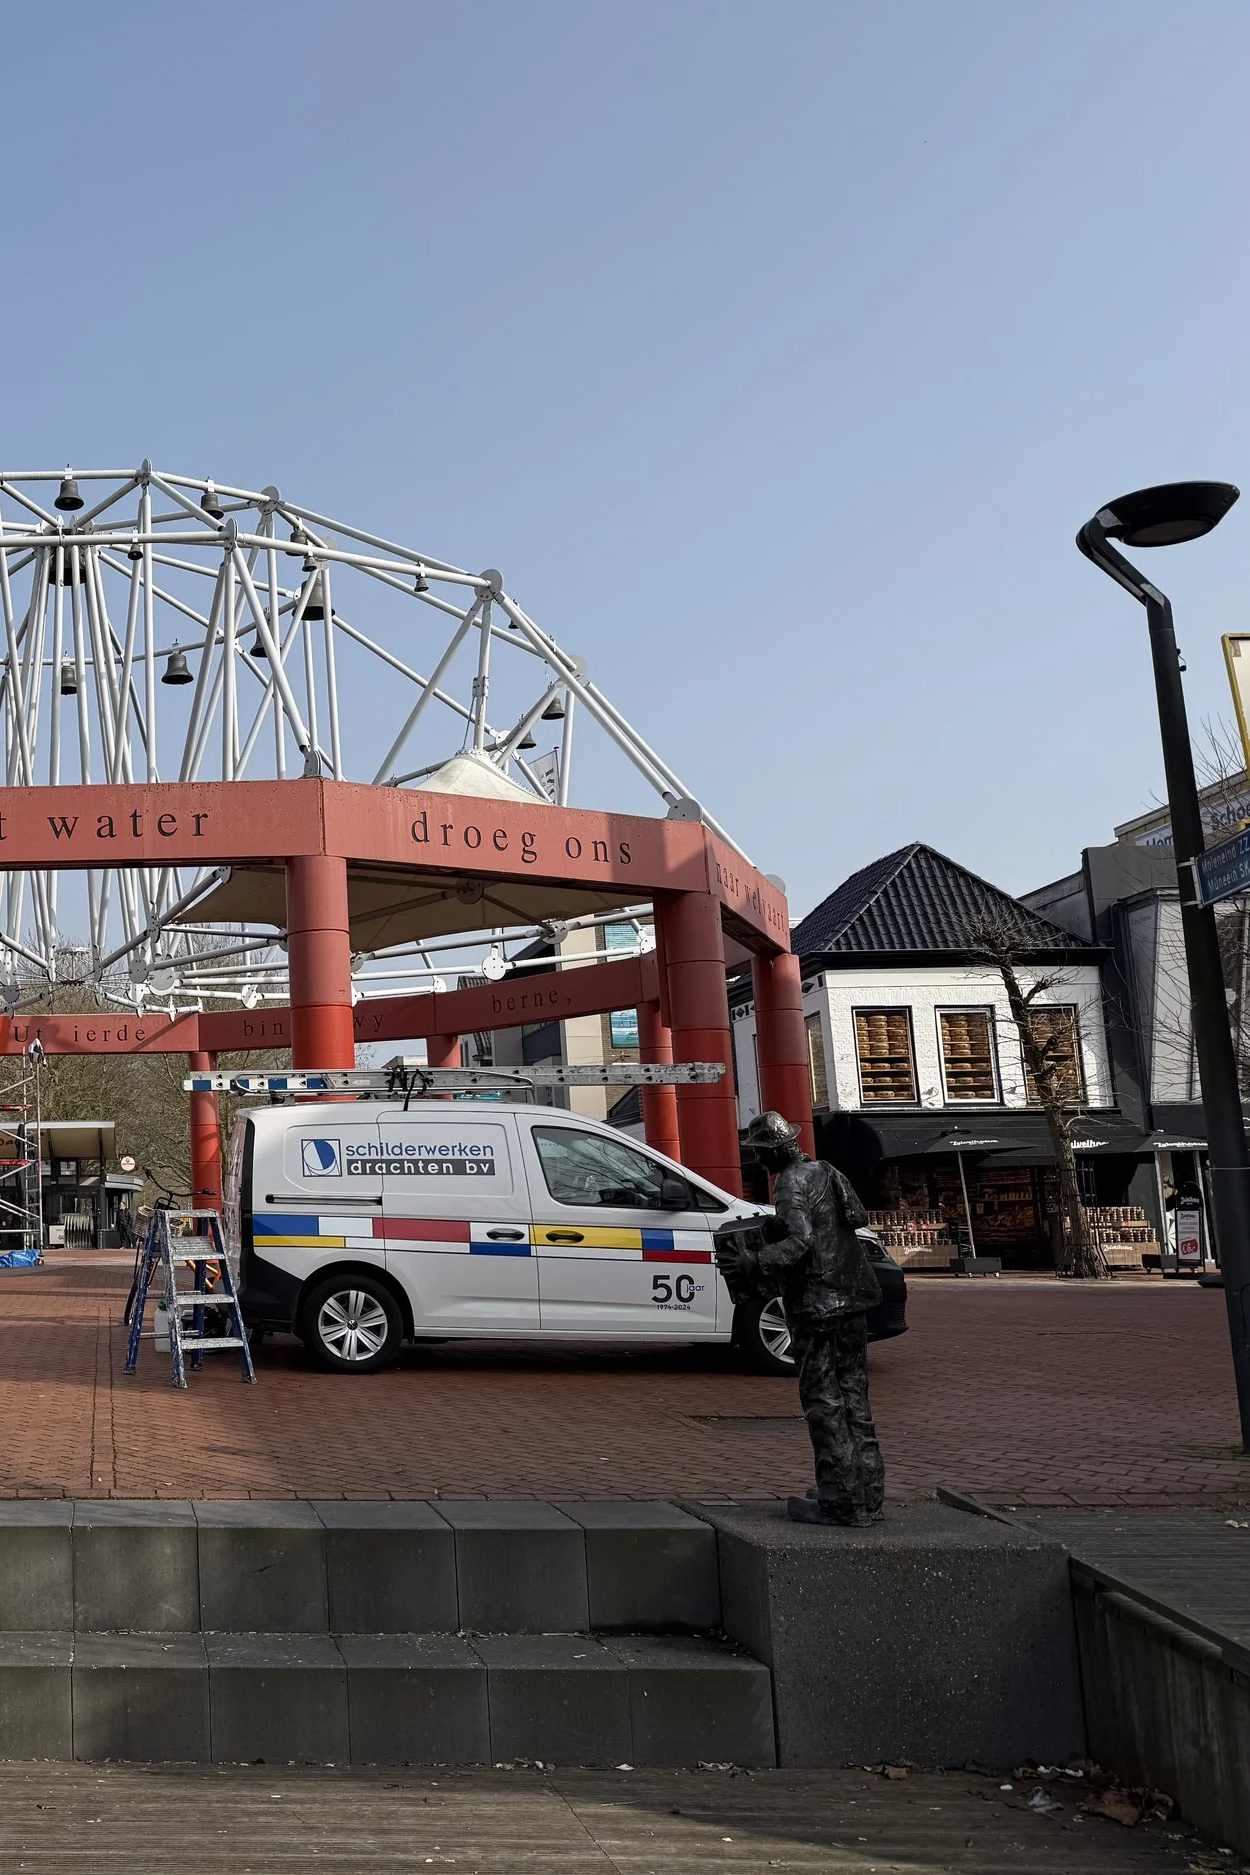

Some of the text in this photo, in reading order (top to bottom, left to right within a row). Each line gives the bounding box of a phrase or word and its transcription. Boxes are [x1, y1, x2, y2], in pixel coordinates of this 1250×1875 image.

[46, 808, 210, 839] water
[410, 811, 633, 865] droeg ons
[1202, 836, 1250, 873] Moleneind ZZ
[715, 862, 740, 898] naar
[1239, 859, 1250, 878] SK
[492, 990, 572, 1013] berne,
[13, 1025, 147, 1042] Ut ierde
[345, 1142, 494, 1157] schilderwerken
[350, 1160, 490, 1174] drachten bv
[651, 1274, 705, 1303] 50 jaar
